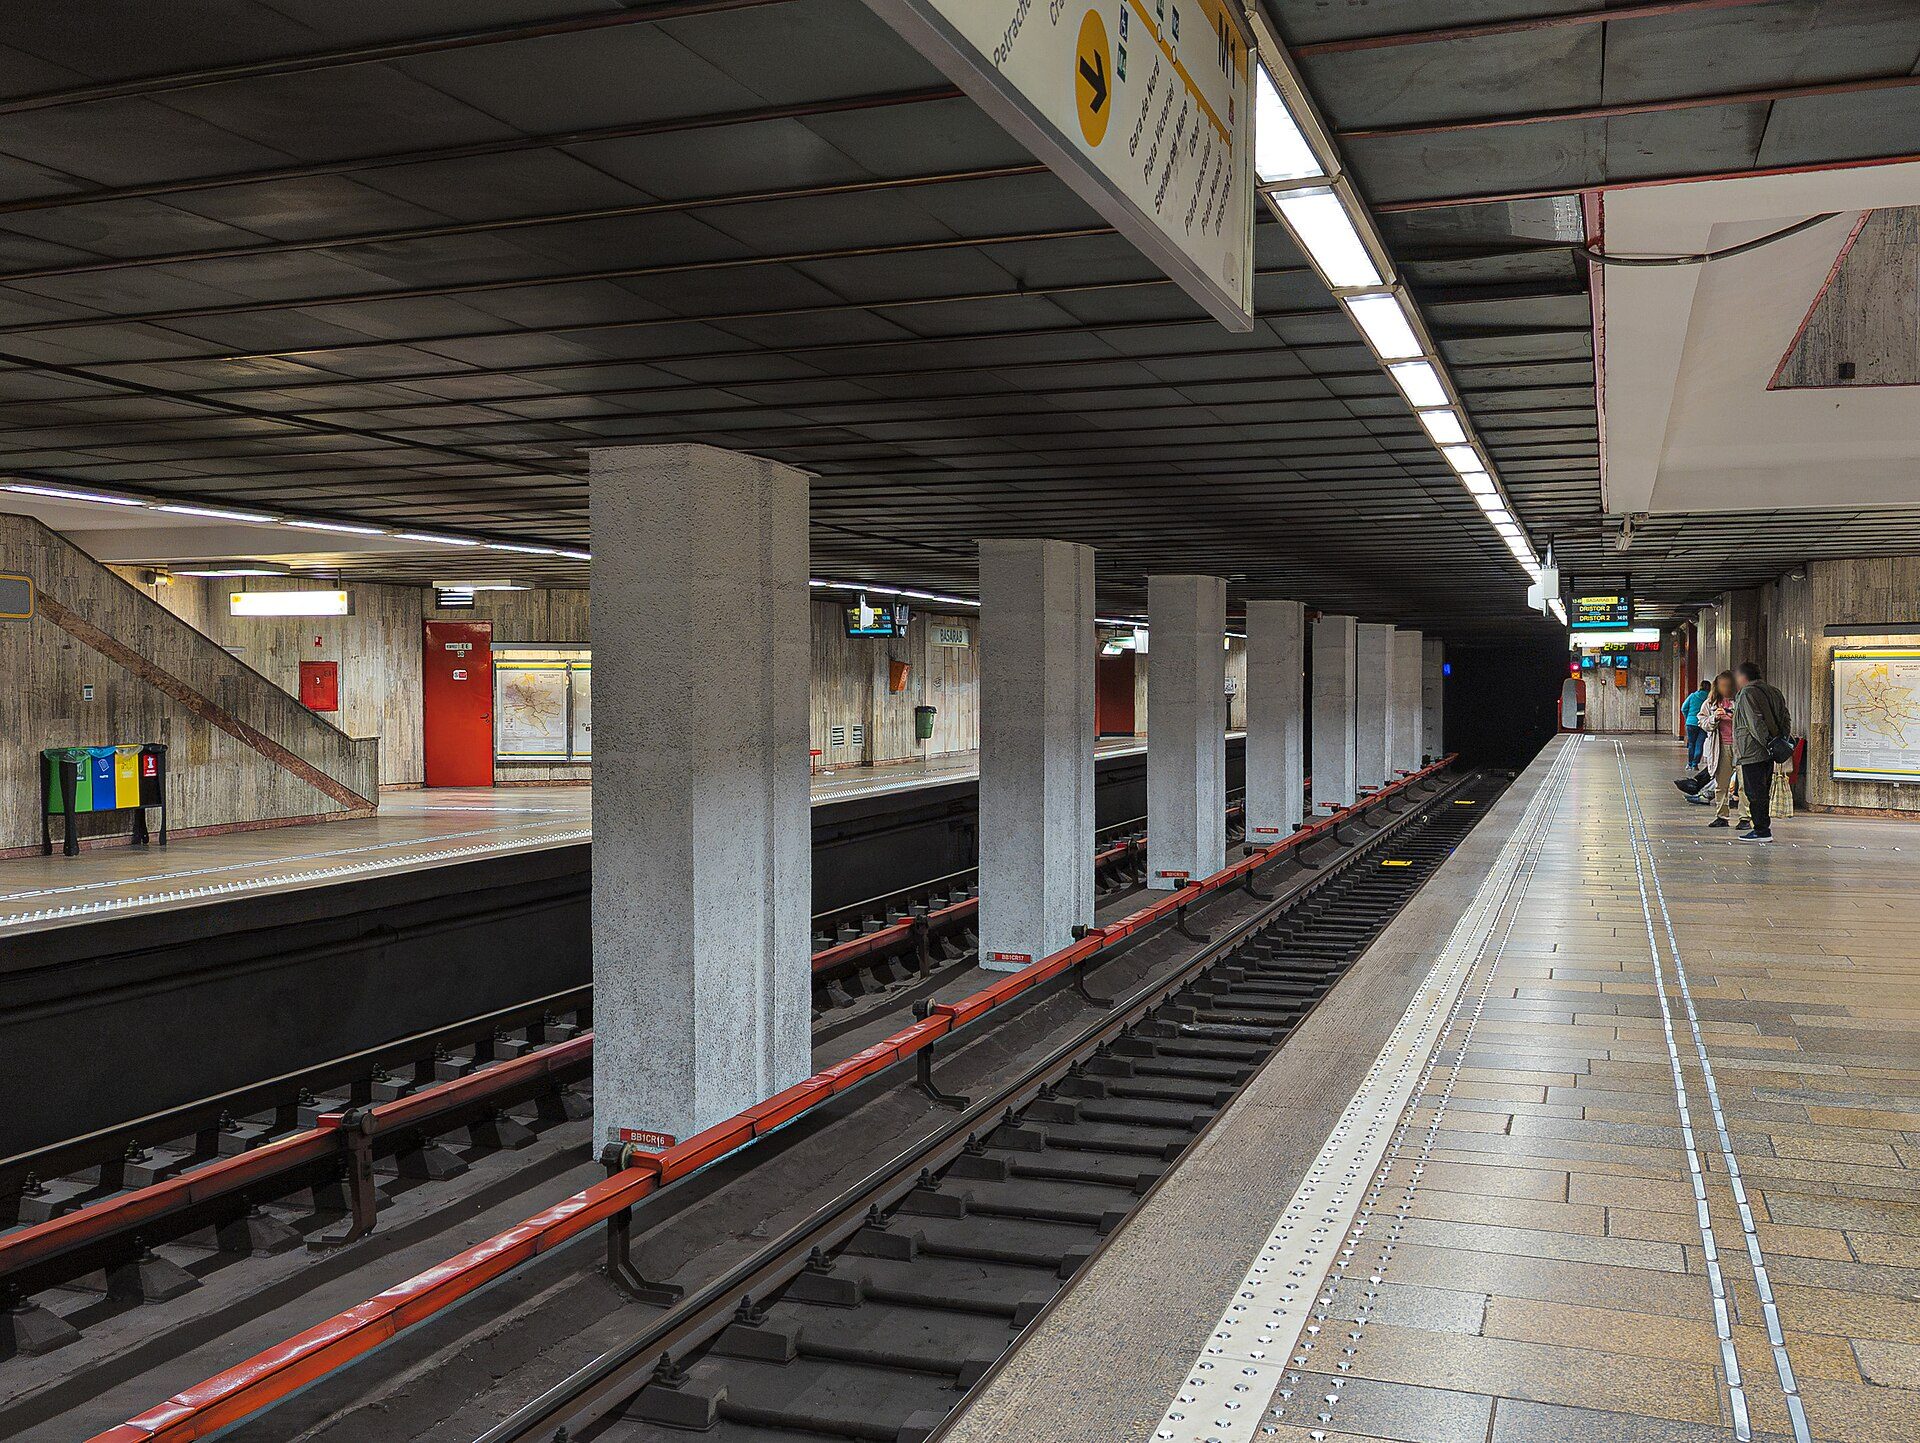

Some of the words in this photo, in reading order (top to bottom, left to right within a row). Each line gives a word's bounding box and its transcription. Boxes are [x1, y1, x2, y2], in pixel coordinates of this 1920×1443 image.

[1218, 10, 1236, 90] M1
[1129, 117, 1143, 157] Gara
[1142, 97, 1149, 121] de
[1147, 54, 1160, 102] Nord
[1155, 78, 1175, 145] Victoriei
[1176, 99, 1188, 142] Mare
[940, 628, 963, 643] BASARAB
[630, 1131, 665, 1147] BB1CR16
